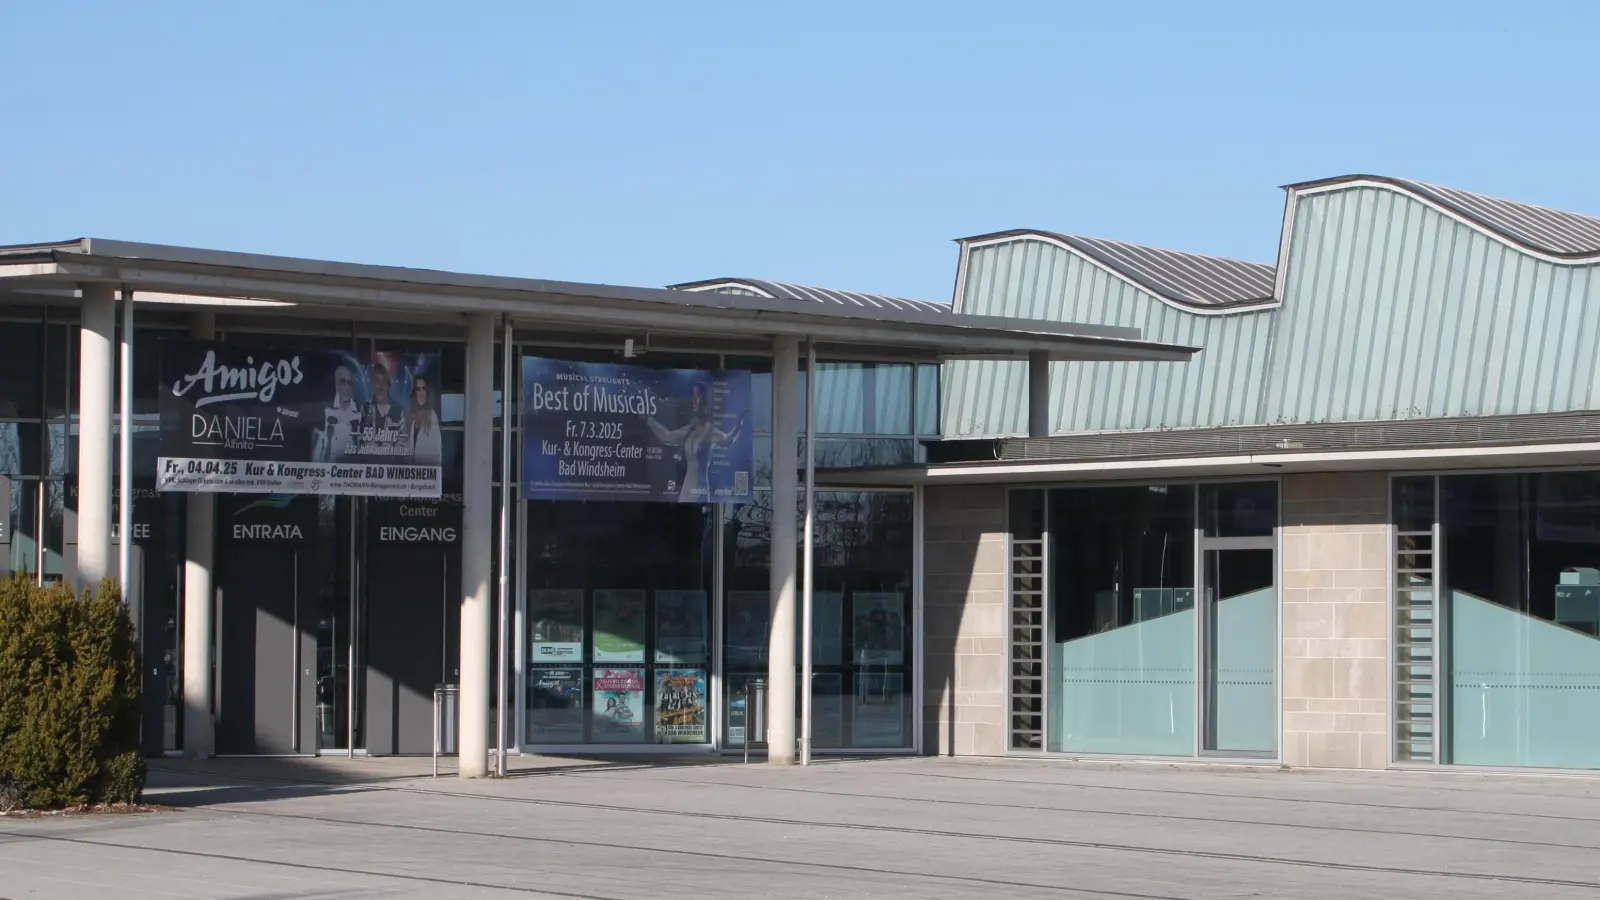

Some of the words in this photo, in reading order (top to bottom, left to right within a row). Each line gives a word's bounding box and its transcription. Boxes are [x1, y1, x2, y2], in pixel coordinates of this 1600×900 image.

[172, 350, 304, 402] Amigos
[533, 383, 569, 411] Best
[573, 385, 589, 412] of
[593, 386, 657, 415] Musicals
[192, 414, 285, 441] DANIELA
[375, 428, 399, 442] Jahre
[566, 420, 578, 437] Fr.
[580, 421, 623, 439] 7.3.2025
[542, 439, 562, 457] Kur-
[563, 441, 572, 456] &
[573, 441, 643, 461] Kongress-Center
[187, 461, 237, 475] 04.04.25
[245, 463, 265, 476] Kur
[267, 463, 275, 476] &
[277, 464, 364, 480] Kongress-Center
[365, 466, 384, 479] BAD
[386, 467, 437, 480] WINDSHEIM
[558, 459, 576, 476] Bad
[577, 460, 626, 477] Windsheim
[399, 504, 438, 517] Center
[233, 524, 303, 539] ENTRATA
[380, 526, 456, 541] EINGANG
